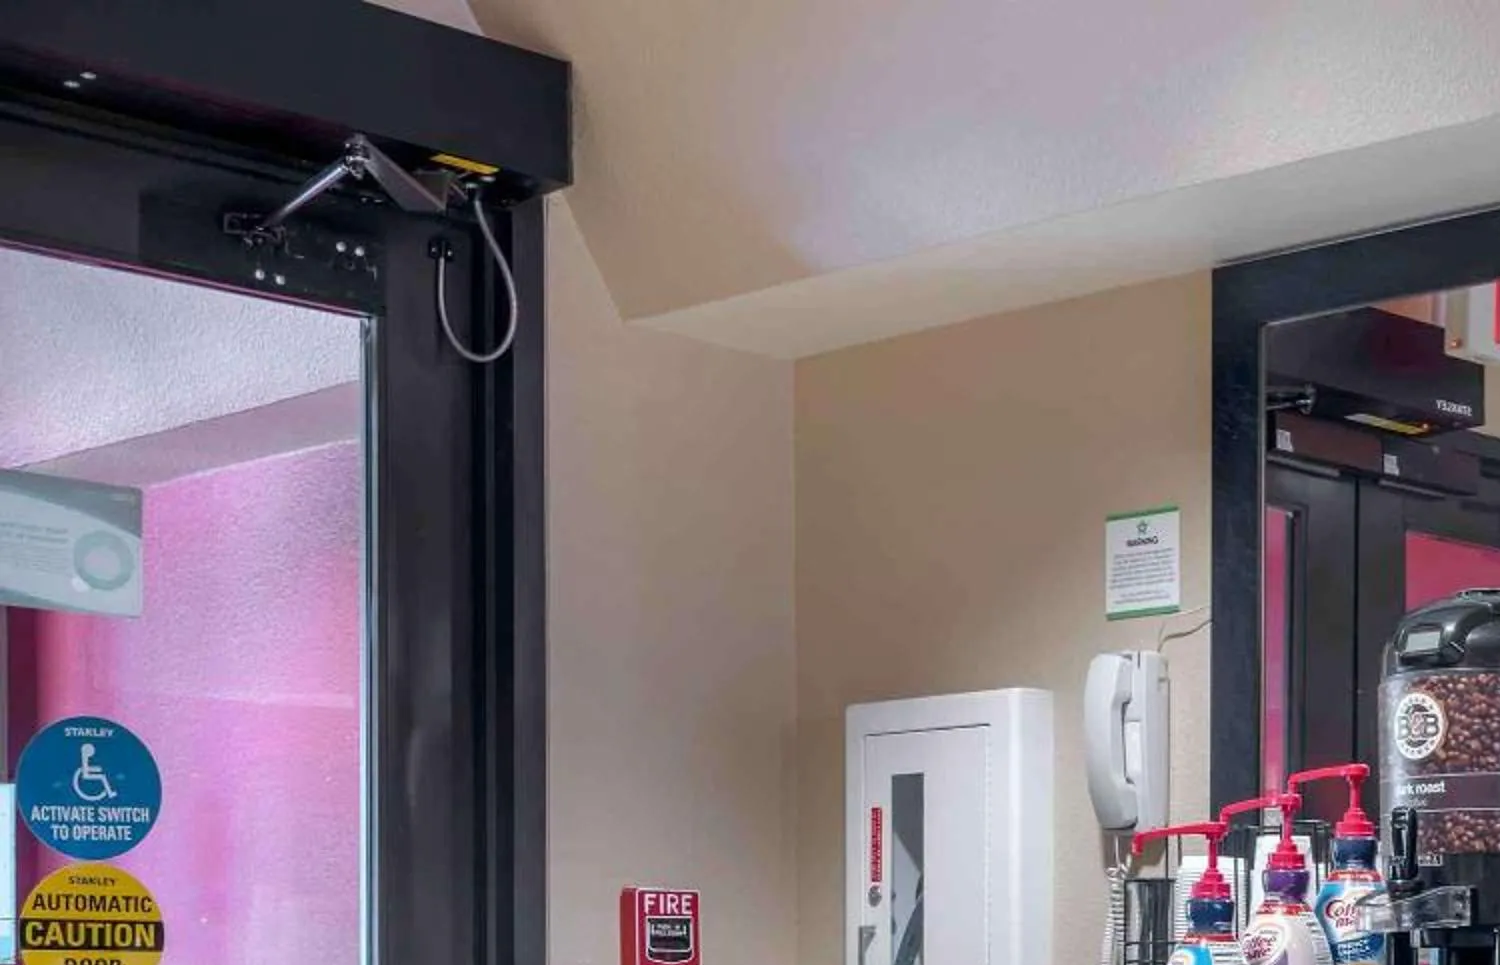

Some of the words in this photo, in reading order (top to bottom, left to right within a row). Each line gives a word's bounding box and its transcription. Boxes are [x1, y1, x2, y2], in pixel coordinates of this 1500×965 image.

[1416, 780, 1446, 794] roast
[31, 806, 96, 823] ACTIVATE
[98, 806, 150, 823] SWITCH
[52, 826, 69, 841] TO
[73, 825, 132, 841] OPERATE
[32, 893, 153, 914] AUTOMATIC
[643, 893, 693, 915] FIRE
[25, 921, 156, 948] CAUTION
